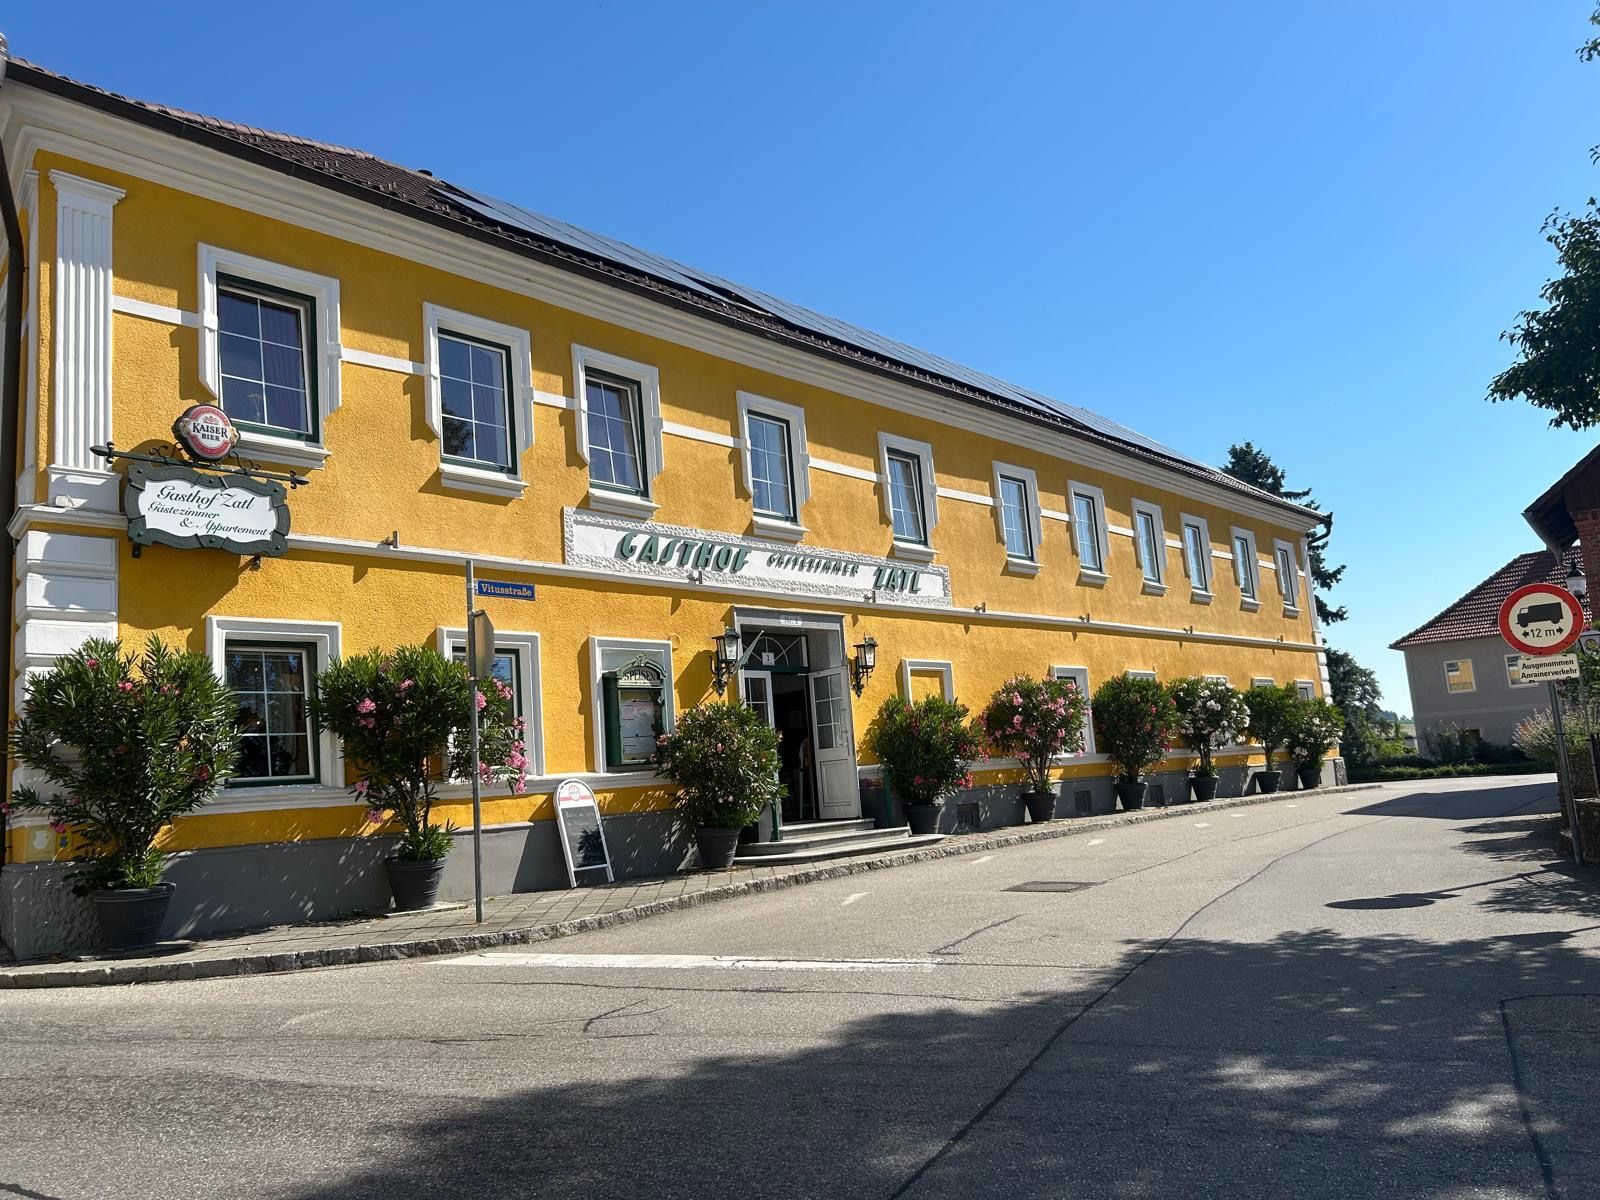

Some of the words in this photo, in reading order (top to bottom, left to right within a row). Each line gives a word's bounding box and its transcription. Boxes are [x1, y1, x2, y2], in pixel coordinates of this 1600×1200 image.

[192, 422, 228, 438] KAISER
[201, 433, 220, 441] BIER
[157, 485, 222, 509] Gasthof
[220, 493, 255, 509] Zatl
[147, 501, 219, 518] Gästezimmer
[179, 517, 193, 528] &
[195, 519, 268, 536] Appartement
[615, 531, 752, 573] GASTHOF
[872, 565, 921, 594] ZATL
[481, 584, 532, 596] Vitusstraße
[1530, 628, 1542, 638] 12
[1545, 629, 1555, 637] m
[1521, 659, 1574, 670] Ausgenommen
[624, 669, 656, 681] SPEISEN
[1521, 668, 1577, 678] Anrainerverkehr
